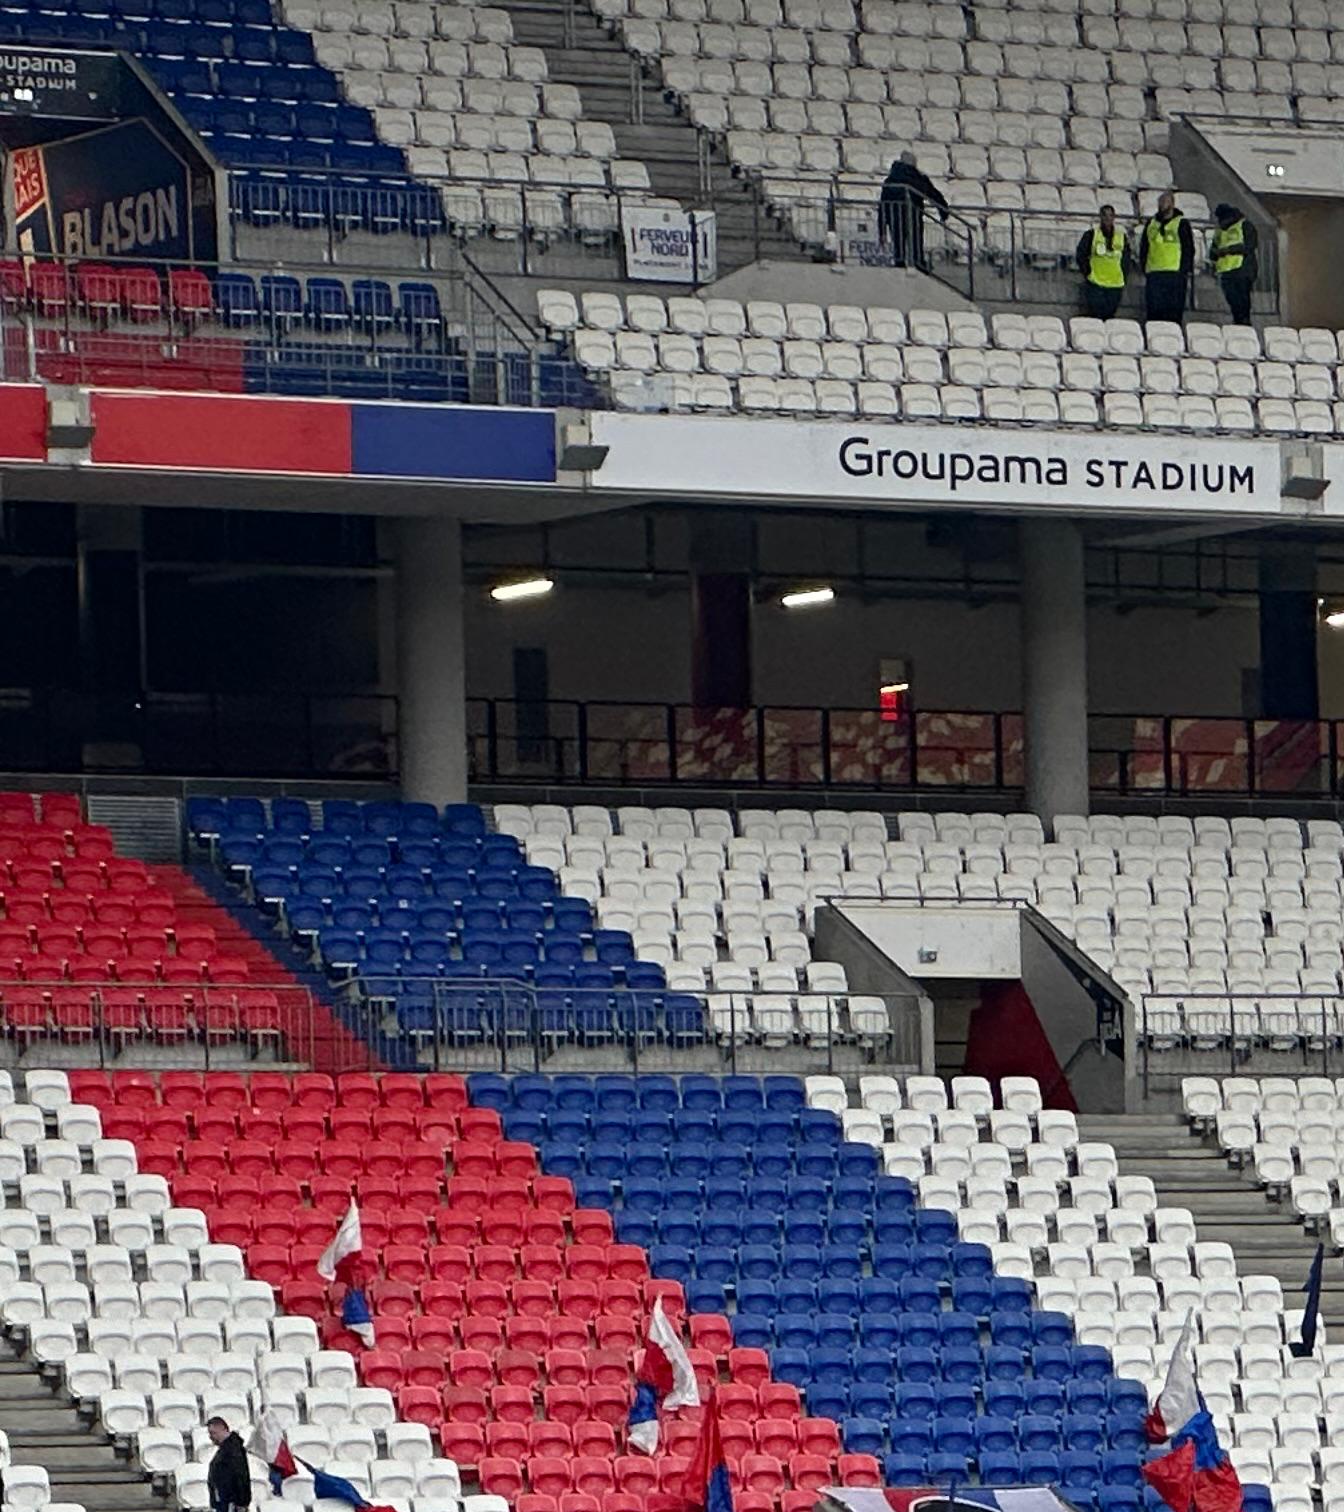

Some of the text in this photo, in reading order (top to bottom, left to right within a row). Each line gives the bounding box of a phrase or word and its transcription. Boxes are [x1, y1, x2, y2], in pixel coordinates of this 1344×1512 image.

[0, 56, 77, 75] upama
[63, 184, 178, 265] BLASON
[838, 436, 1255, 494] Groupama STADIUM
